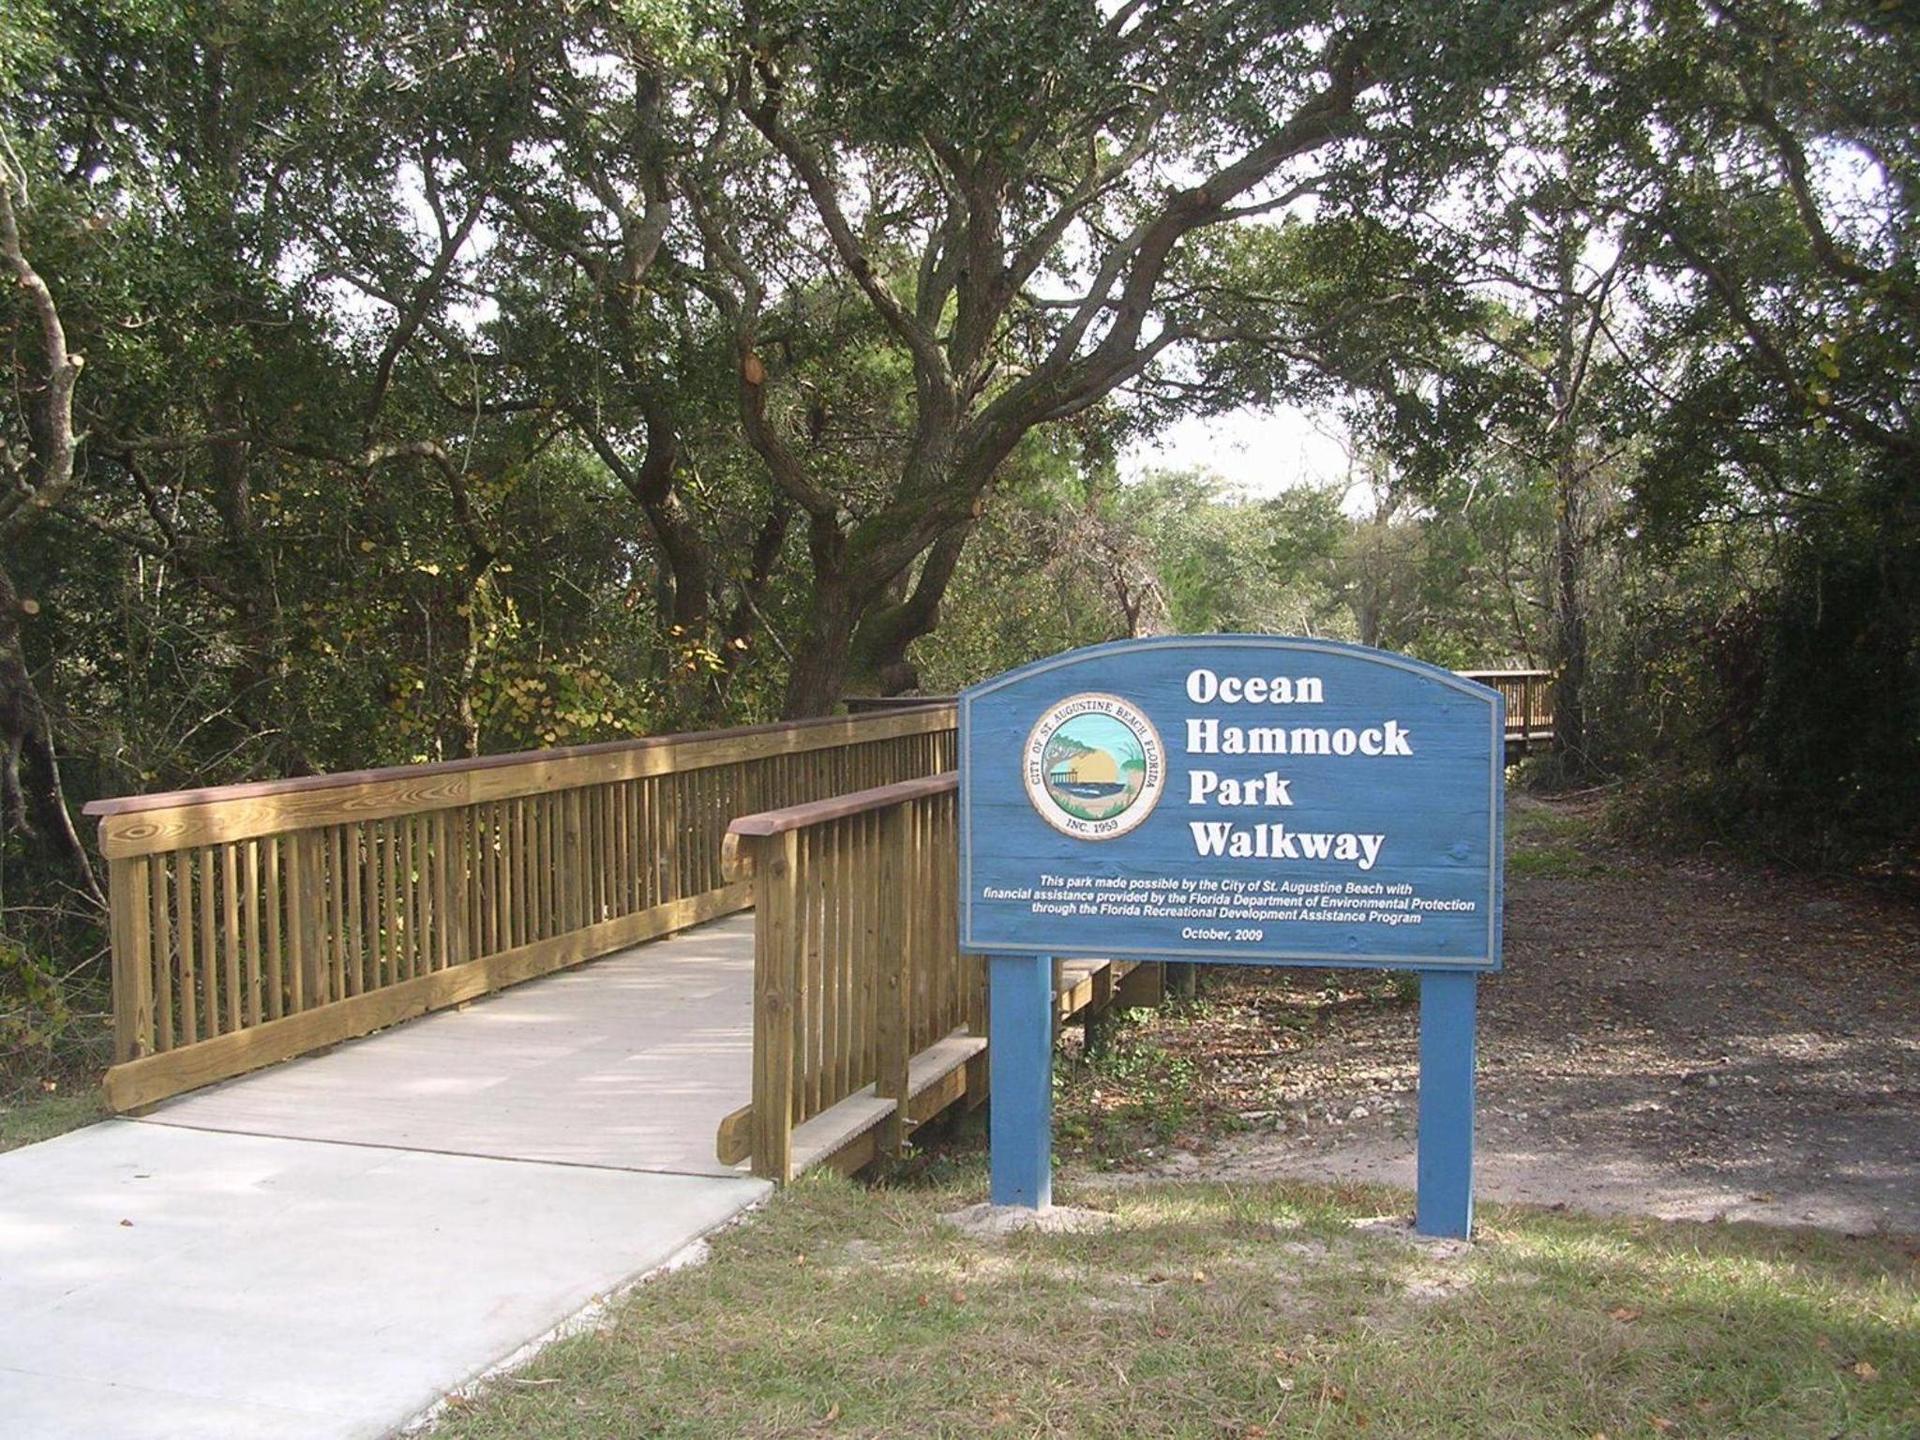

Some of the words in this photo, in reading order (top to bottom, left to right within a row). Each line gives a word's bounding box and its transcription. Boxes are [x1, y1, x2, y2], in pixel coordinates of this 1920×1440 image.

[1186, 669, 1324, 704] Ocean
[1054, 700, 1113, 722] AUGUSTINE
[1116, 706, 1148, 736] BEACH
[1040, 722, 1055, 737] ST.
[1186, 718, 1413, 756] Hammock
[1032, 740, 1043, 754] OF
[1030, 761, 1040, 785] CITY
[1144, 740, 1158, 788] FLORIDA
[1188, 770, 1294, 806] Park
[1066, 818, 1089, 833] INC.
[1188, 821, 1385, 870] Walkway
[1040, 875, 1064, 887] This
[1067, 877, 1092, 890] park
[1095, 877, 1127, 889] made
[1129, 878, 1179, 891] possible
[1182, 879, 1197, 892] by
[1199, 879, 1218, 890] the
[1221, 880, 1244, 893] City
[1247, 880, 1261, 892] of
[1263, 881, 1278, 892] St.
[1281, 881, 1342, 895] Augustine
[1345, 882, 1383, 894] Beach
[1386, 883, 1412, 895] with
[983, 887, 1031, 899] financial
[1033, 889, 1094, 901] assistance
[1096, 891, 1148, 903] provided
[1151, 892, 1165, 905] by
[1168, 892, 1186, 904] the
[1189, 893, 1230, 905] Florida
[1233, 895, 1302, 909] Department
[1305, 896, 1319, 908] of
[1320, 898, 1408, 910] Environmental
[1411, 899, 1475, 912] Protection
[1032, 903, 1076, 916] through
[1079, 904, 1098, 915] the
[1099, 904, 1141, 916] Florida
[1143, 906, 1217, 918] Recreational
[1219, 908, 1298, 922] Development
[1299, 911, 1366, 923] Assistance
[1368, 912, 1422, 926] Program
[1182, 927, 1232, 941] October,
[1235, 929, 1263, 941] 2009
